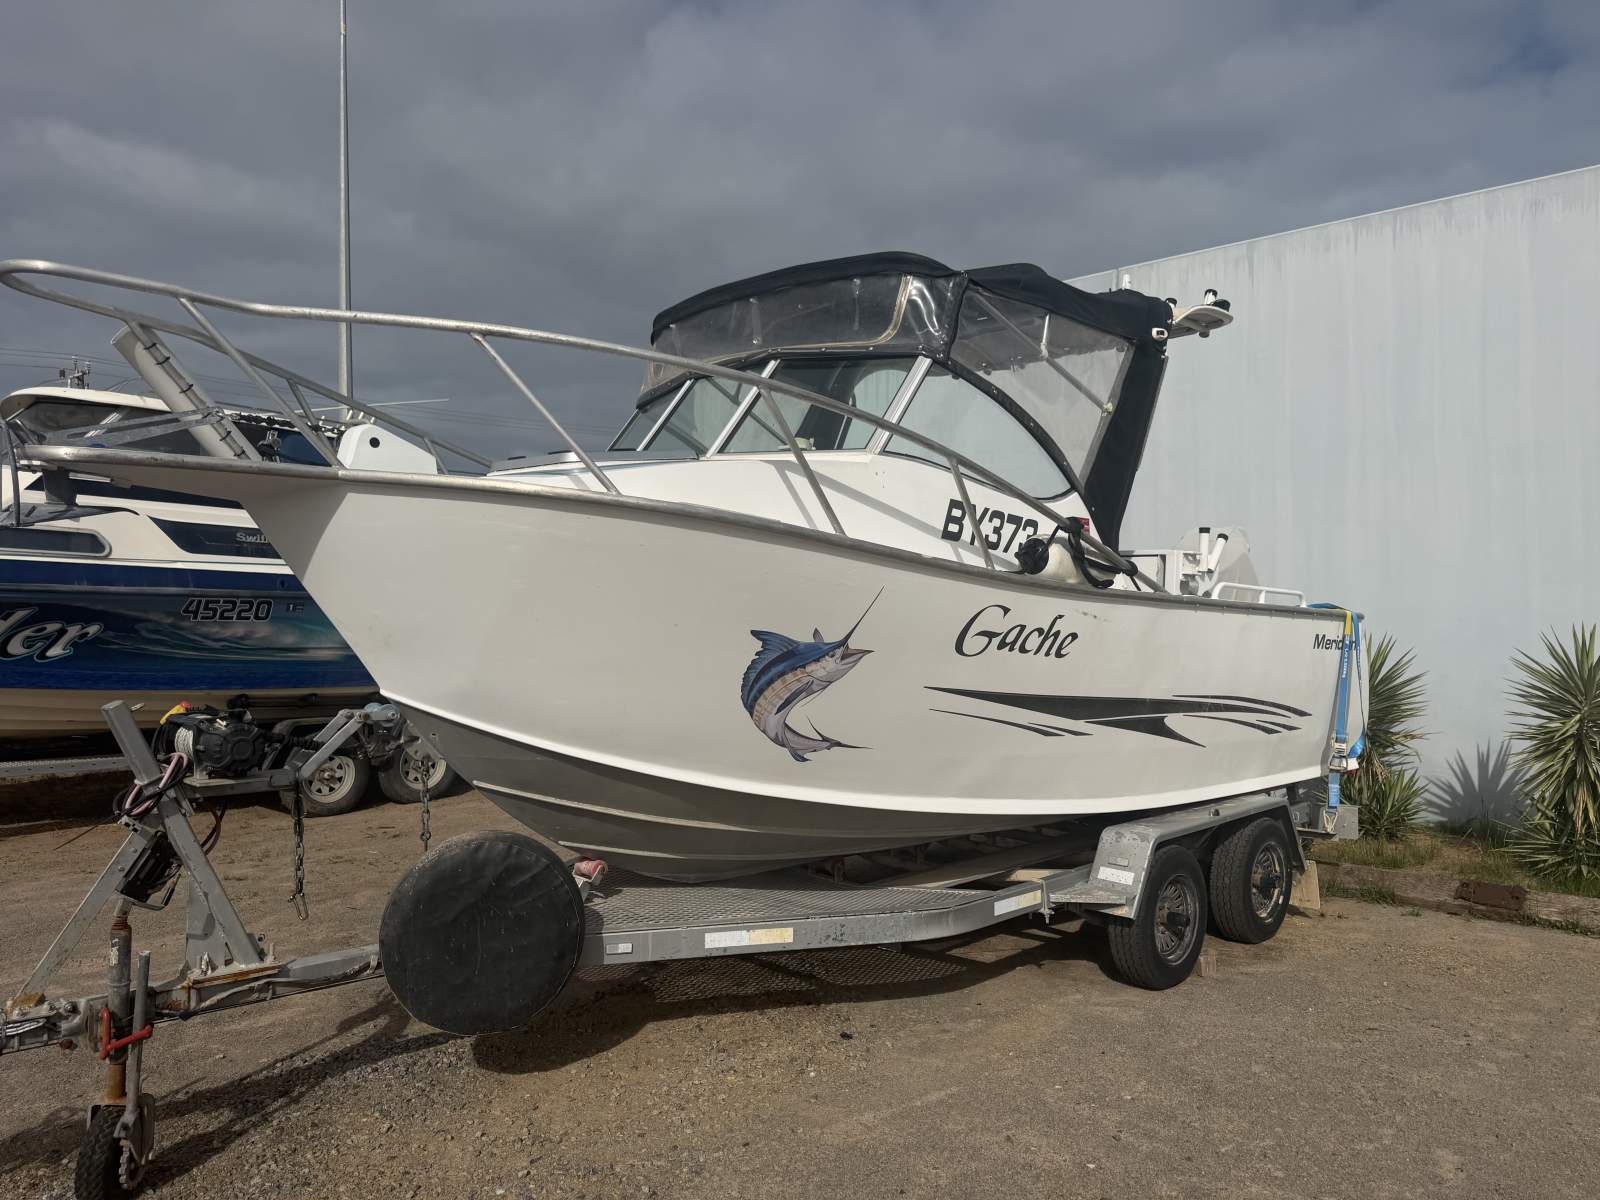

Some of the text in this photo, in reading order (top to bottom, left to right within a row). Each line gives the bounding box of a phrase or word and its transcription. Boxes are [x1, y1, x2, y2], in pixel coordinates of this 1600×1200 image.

[181, 597, 273, 622] 45220
[955, 604, 1078, 658] Gache
[1313, 634, 1357, 651] Meridn
